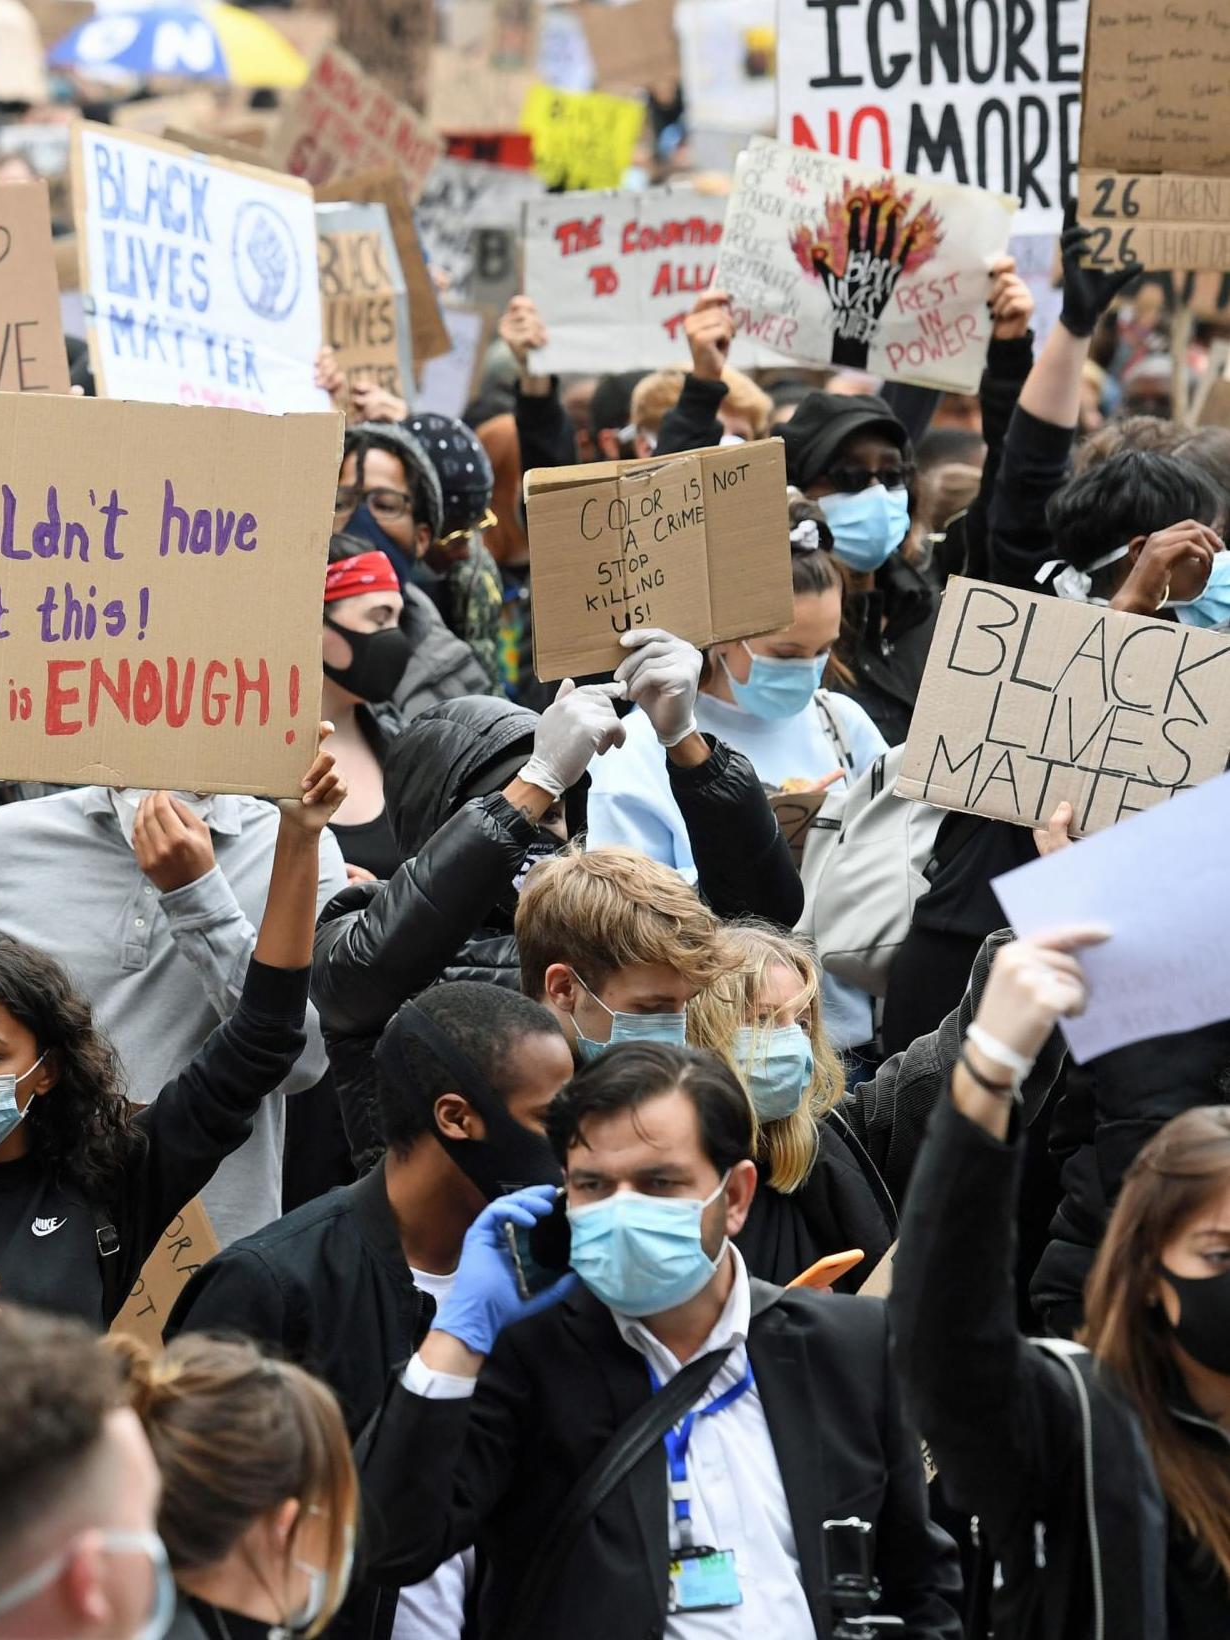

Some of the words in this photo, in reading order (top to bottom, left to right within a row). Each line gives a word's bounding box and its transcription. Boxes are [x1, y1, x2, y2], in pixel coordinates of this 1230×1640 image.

[806, 0, 1080, 88] IGNORE
[906, 93, 1080, 208] MORE
[95, 143, 212, 244] BLACK
[1092, 178, 1140, 218] 26
[1152, 178, 1220, 217] TAKEN
[555, 214, 604, 257] THE
[1090, 227, 1138, 265] 26
[103, 228, 211, 314] LIVES
[587, 264, 619, 297] TO
[895, 271, 963, 315] REST
[109, 304, 266, 395] MATTER
[727, 302, 799, 350] OWER
[885, 312, 985, 373] POWER
[916, 307, 943, 337] IN
[159, 479, 257, 556] have
[580, 489, 663, 541] COLOR
[684, 478, 702, 502] IS
[713, 464, 750, 494] NOT
[598, 553, 649, 585] STOP
[625, 529, 639, 553] A
[37, 583, 150, 643] this!
[612, 603, 652, 633] US!
[947, 587, 1230, 725] BLACK
[9, 680, 33, 722] is
[46, 658, 300, 745] ENOUGH!
[984, 681, 1200, 788] LIVES
[35, 1217, 58, 1231] NIKE
